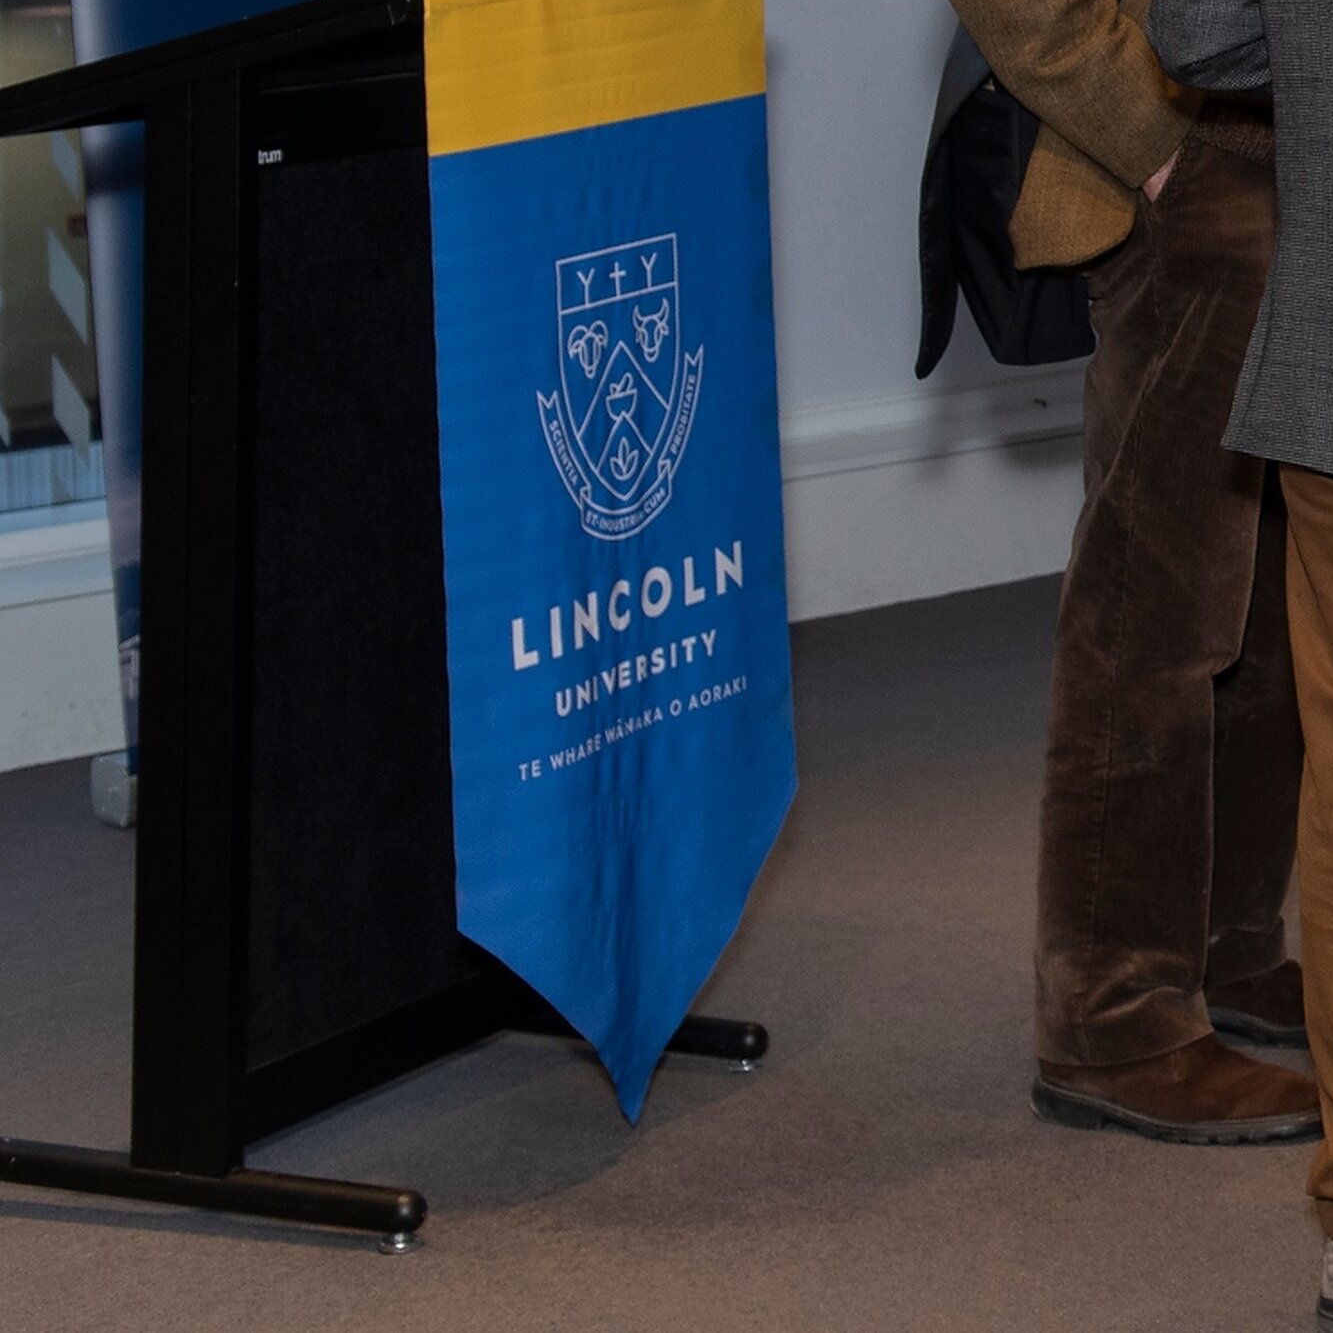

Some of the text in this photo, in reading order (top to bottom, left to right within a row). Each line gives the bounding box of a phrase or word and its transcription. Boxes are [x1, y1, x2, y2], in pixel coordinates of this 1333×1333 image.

[643, 487, 666, 514] CUM
[511, 540, 744, 671] LINCOLN
[555, 629, 717, 717] UNIVERSITY
[519, 759, 542, 781] TE
[550, 734, 601, 771] WHARE
[670, 699, 682, 717] O
[688, 675, 748, 711] AORAKI
